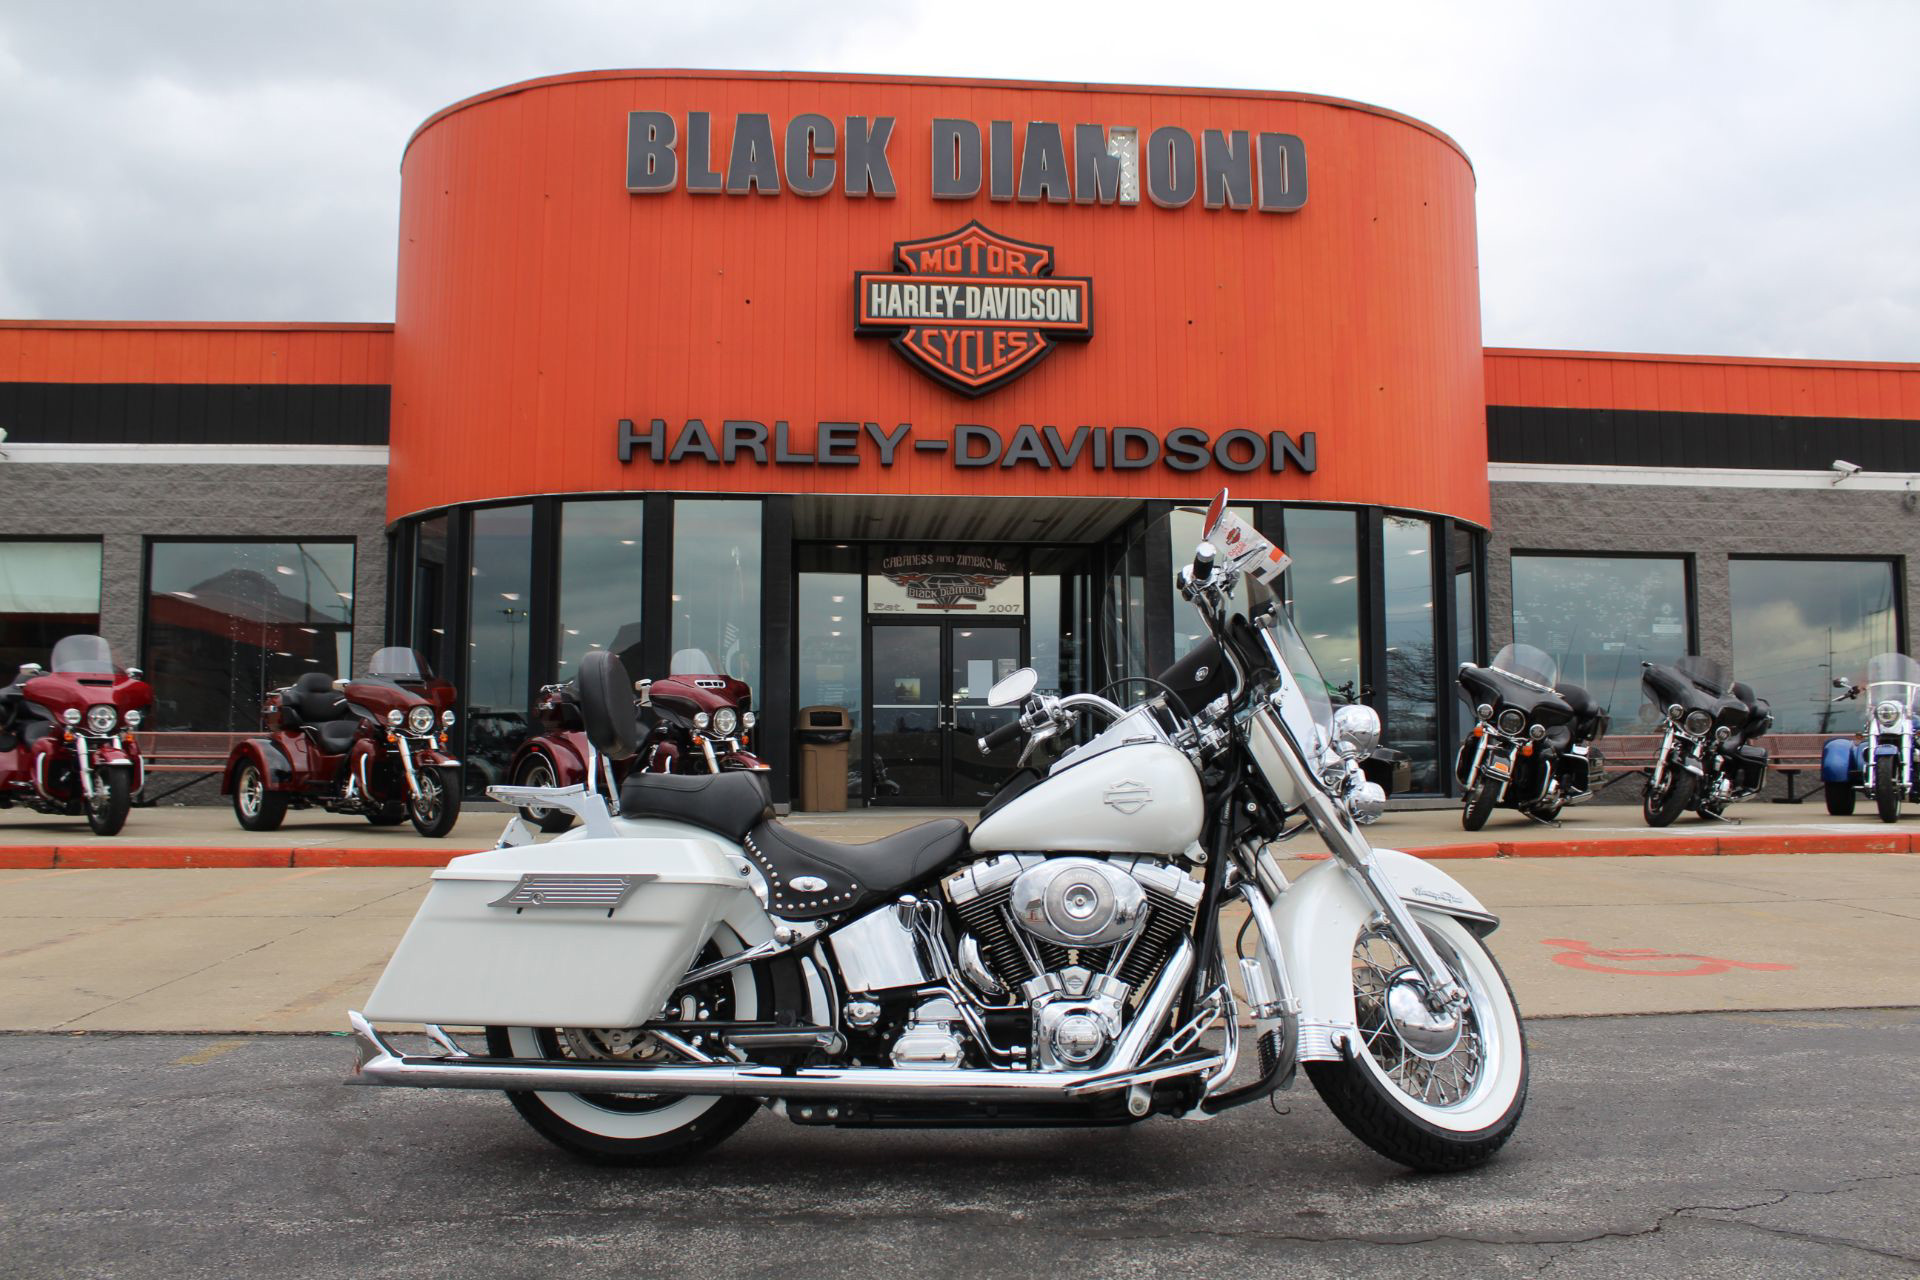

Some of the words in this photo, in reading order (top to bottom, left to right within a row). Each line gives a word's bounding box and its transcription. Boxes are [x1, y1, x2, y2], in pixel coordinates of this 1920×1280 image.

[626, 111, 897, 198] BLACK
[931, 117, 1309, 212] DIAMOND
[920, 236, 1029, 275] MOTOR
[871, 283, 1078, 322] HARLEY-DAVIDSON
[921, 329, 1028, 376] CYCLES
[617, 418, 1317, 473] HARLEY-DAVIDSON
[988, 603, 1020, 613] 2007
